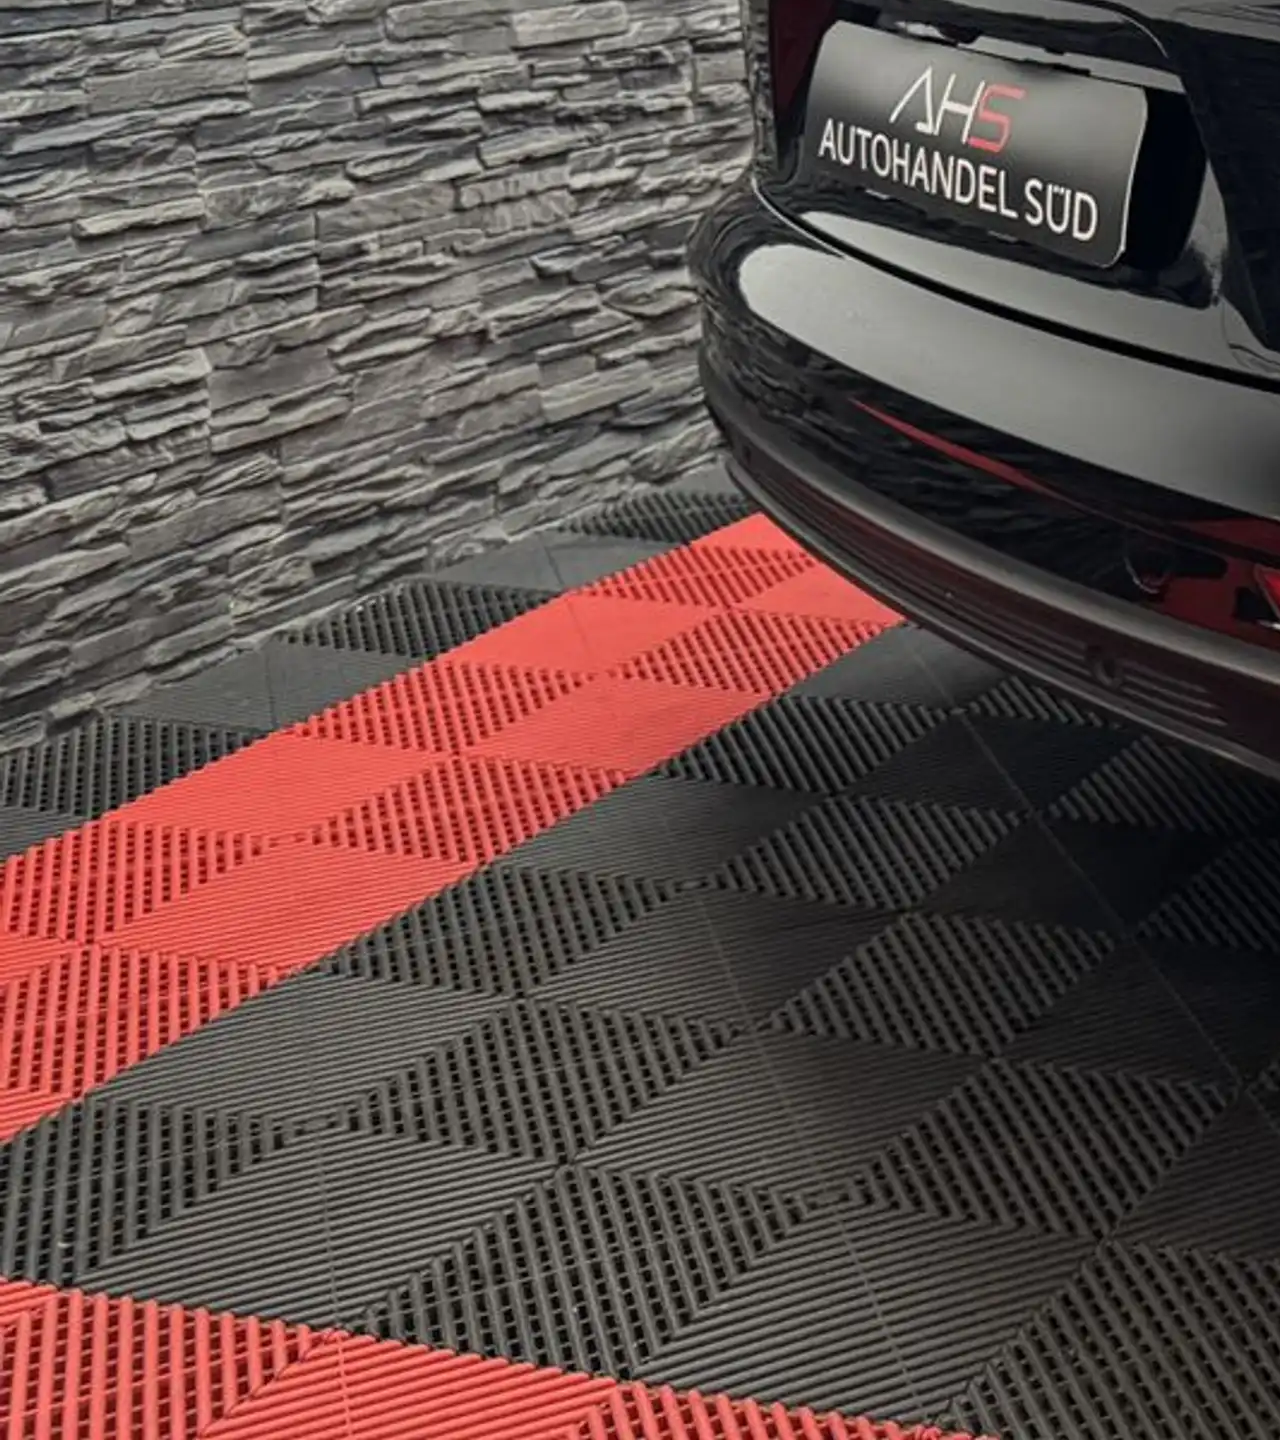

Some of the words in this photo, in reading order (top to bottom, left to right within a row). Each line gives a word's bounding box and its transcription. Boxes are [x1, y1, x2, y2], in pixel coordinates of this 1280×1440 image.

[889, 66, 1026, 153] AHS
[819, 117, 1018, 220] AUTOHANDEL
[1024, 179, 1098, 242] SÜD
